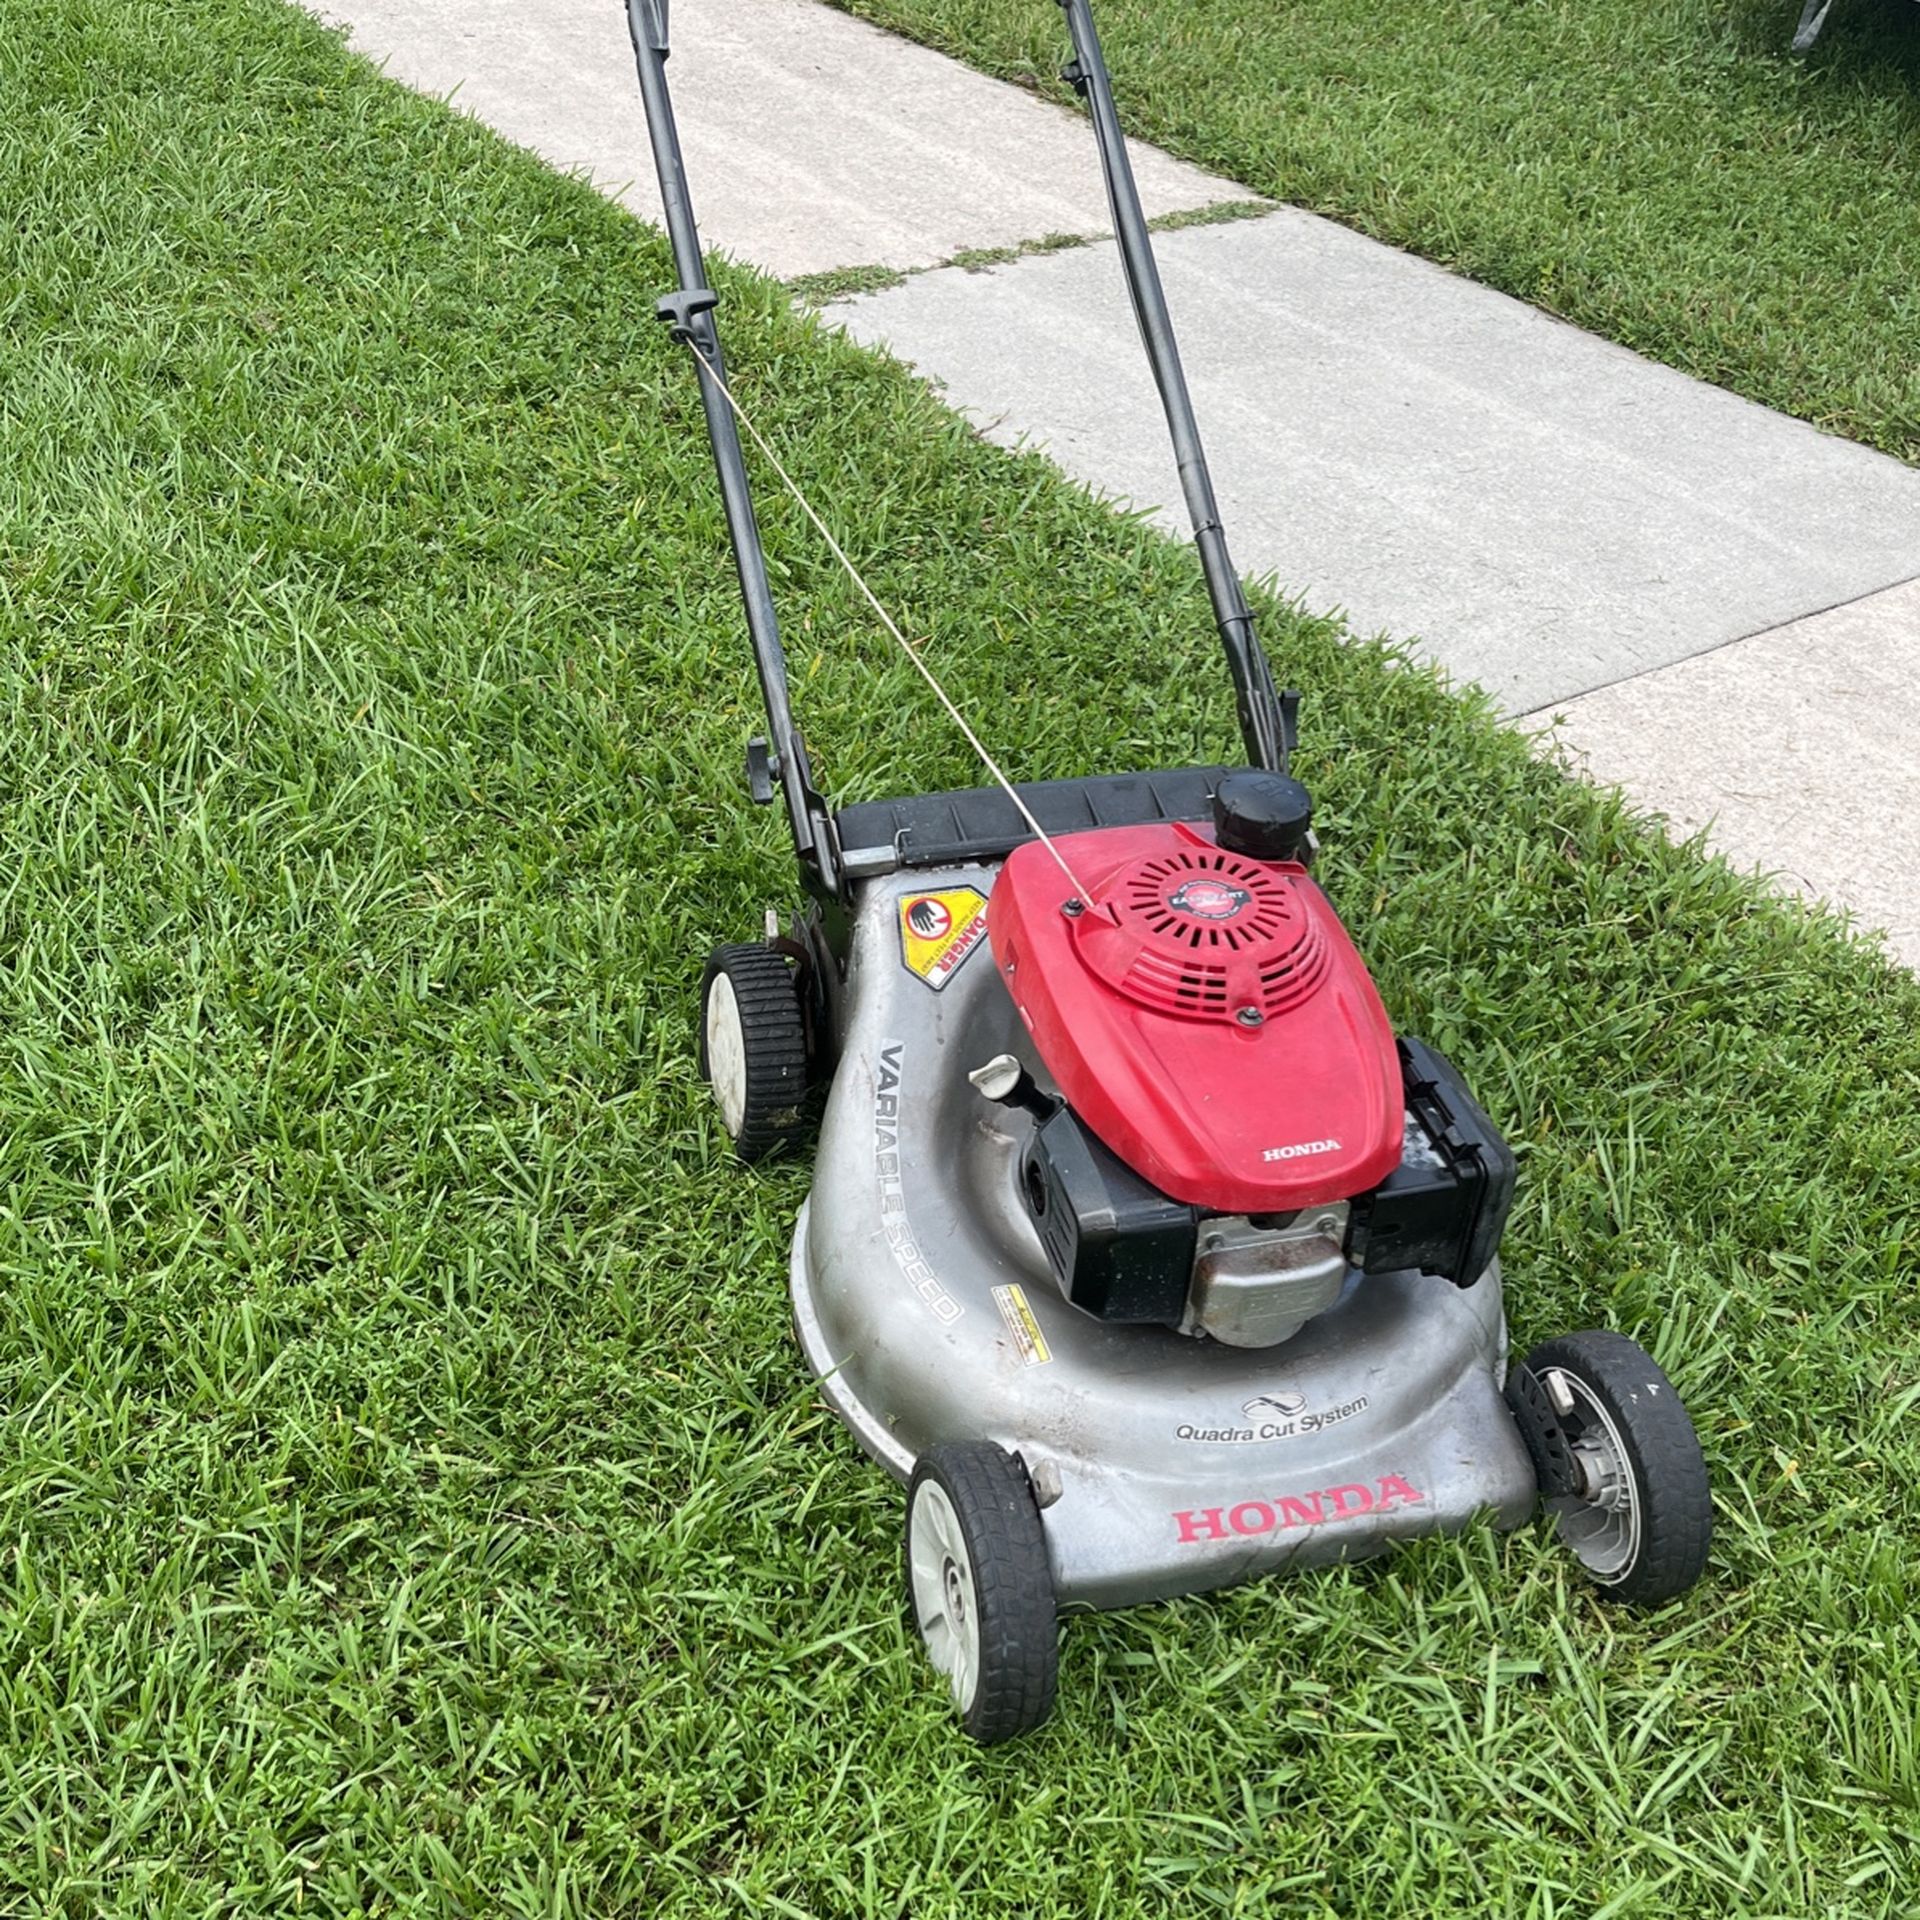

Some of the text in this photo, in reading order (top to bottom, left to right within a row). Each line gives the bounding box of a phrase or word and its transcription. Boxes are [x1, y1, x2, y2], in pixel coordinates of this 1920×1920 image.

[935, 914, 987, 973] DANGER
[1262, 1139, 1342, 1162] HONDA
[875, 1044, 963, 1323] VARIABLE SPEED
[1176, 1396, 1369, 1442] Quadra Cut System
[1172, 1474, 1425, 1543] HONDA
